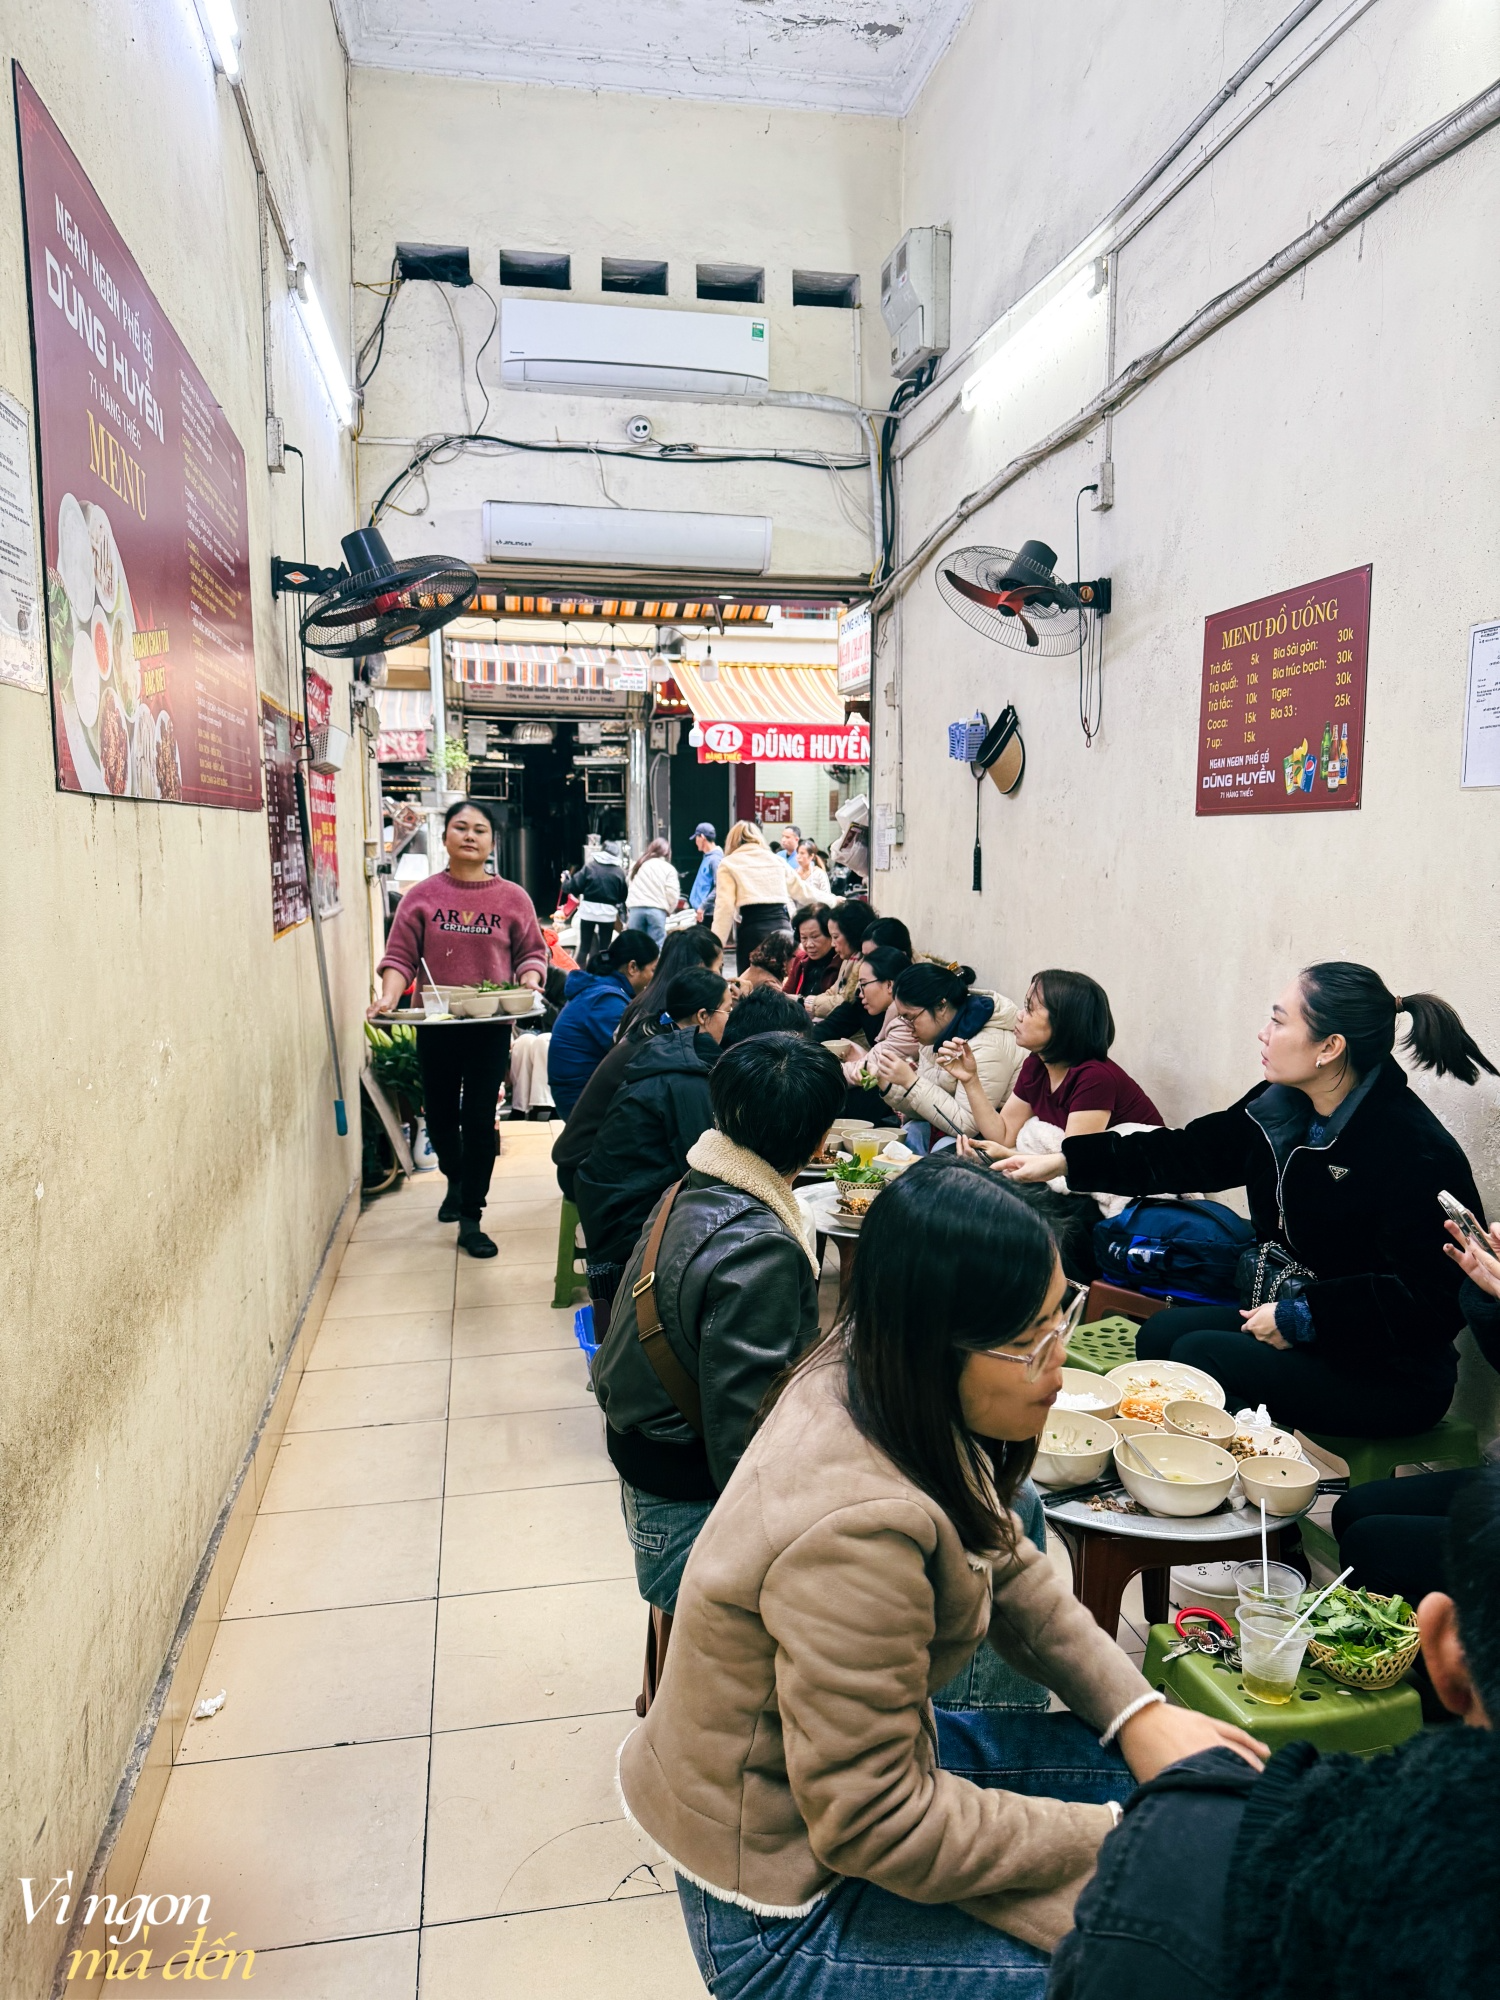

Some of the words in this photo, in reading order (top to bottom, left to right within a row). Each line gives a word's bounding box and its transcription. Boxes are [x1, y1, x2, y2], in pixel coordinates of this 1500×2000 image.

[55, 193, 89, 277] NGAN
[45, 246, 107, 368] DŨNG
[112, 340, 164, 445] HUYỀN
[89, 371, 98, 400] 71
[100, 383, 121, 427] HÀNG
[122, 411, 141, 451] THIẾC
[86, 409, 147, 520] MENU
[1222, 621, 1262, 650] MENU
[1265, 604, 1288, 638] ĐỒ
[1292, 596, 1338, 630] UỐNG
[1273, 647, 1286, 660] Bia
[1286, 642, 1298, 656] Sài
[1300, 638, 1318, 656] gòn:
[1338, 628, 1354, 642] 30k
[1210, 662, 1220, 675] Trà
[1222, 659, 1233, 672] đá:
[1250, 653, 1260, 665] 5k
[1272, 667, 1284, 680] Bia
[1286, 662, 1301, 677] trúc
[1302, 658, 1327, 675] bạch:
[1336, 650, 1352, 664] 30k
[1209, 681, 1219, 694] Trà
[1247, 673, 1258, 686] 10k
[1272, 688, 1292, 701] Tiger:
[1336, 672, 1352, 685] 30k
[1208, 699, 1218, 712] Trà
[1246, 692, 1257, 704] 10k
[1270, 707, 1282, 720] Bia
[1334, 693, 1350, 707] 25k
[1207, 719, 1228, 730] Coca:
[1244, 712, 1256, 724] 15k
[715, 730, 736, 747] 71
[752, 728, 804, 758] DŨNG
[1206, 738, 1211, 748] 7
[1212, 738, 1222, 749] up:
[1244, 731, 1256, 743] 15k
[1210, 758, 1226, 769] NGAN
[1202, 772, 1232, 788] DŨNG
[1236, 764, 1275, 786] HUYỀN
[1226, 790, 1238, 798] HÀNG
[432, 908, 502, 929] ARVAR
[444, 924, 489, 934] CRIMSON
